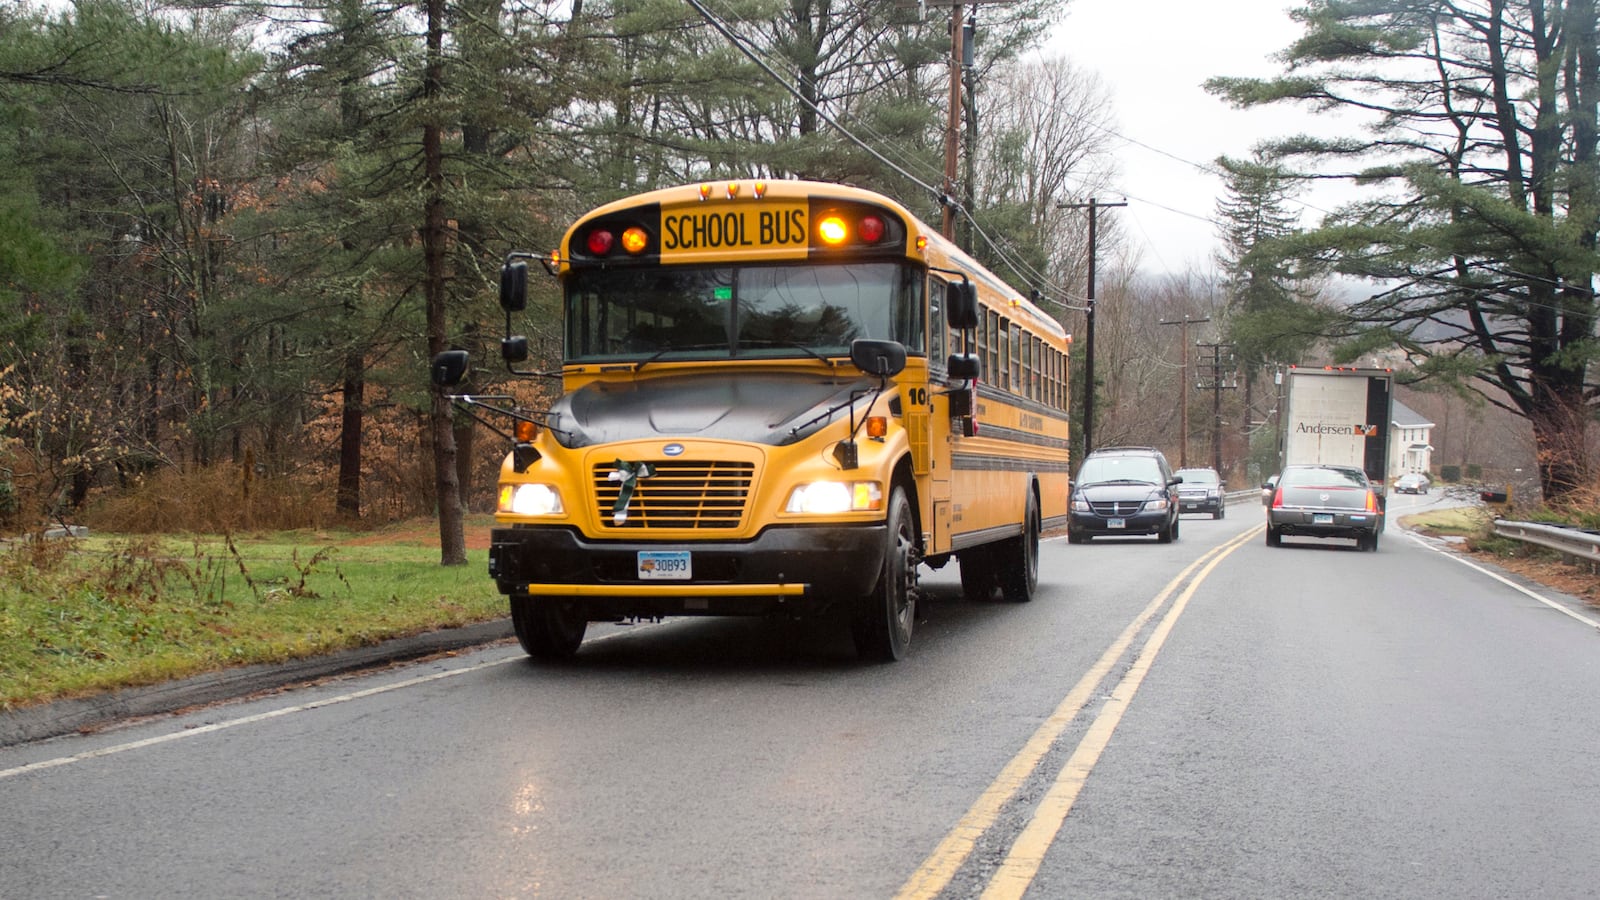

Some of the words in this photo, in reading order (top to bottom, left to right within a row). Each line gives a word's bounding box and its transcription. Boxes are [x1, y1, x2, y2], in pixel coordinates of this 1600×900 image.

[664, 212, 752, 250] SCHOOL
[759, 209, 806, 245] BUS
[908, 387, 926, 406] 10
[1296, 421, 1352, 435] Andersen
[655, 559, 687, 571] 30B93
